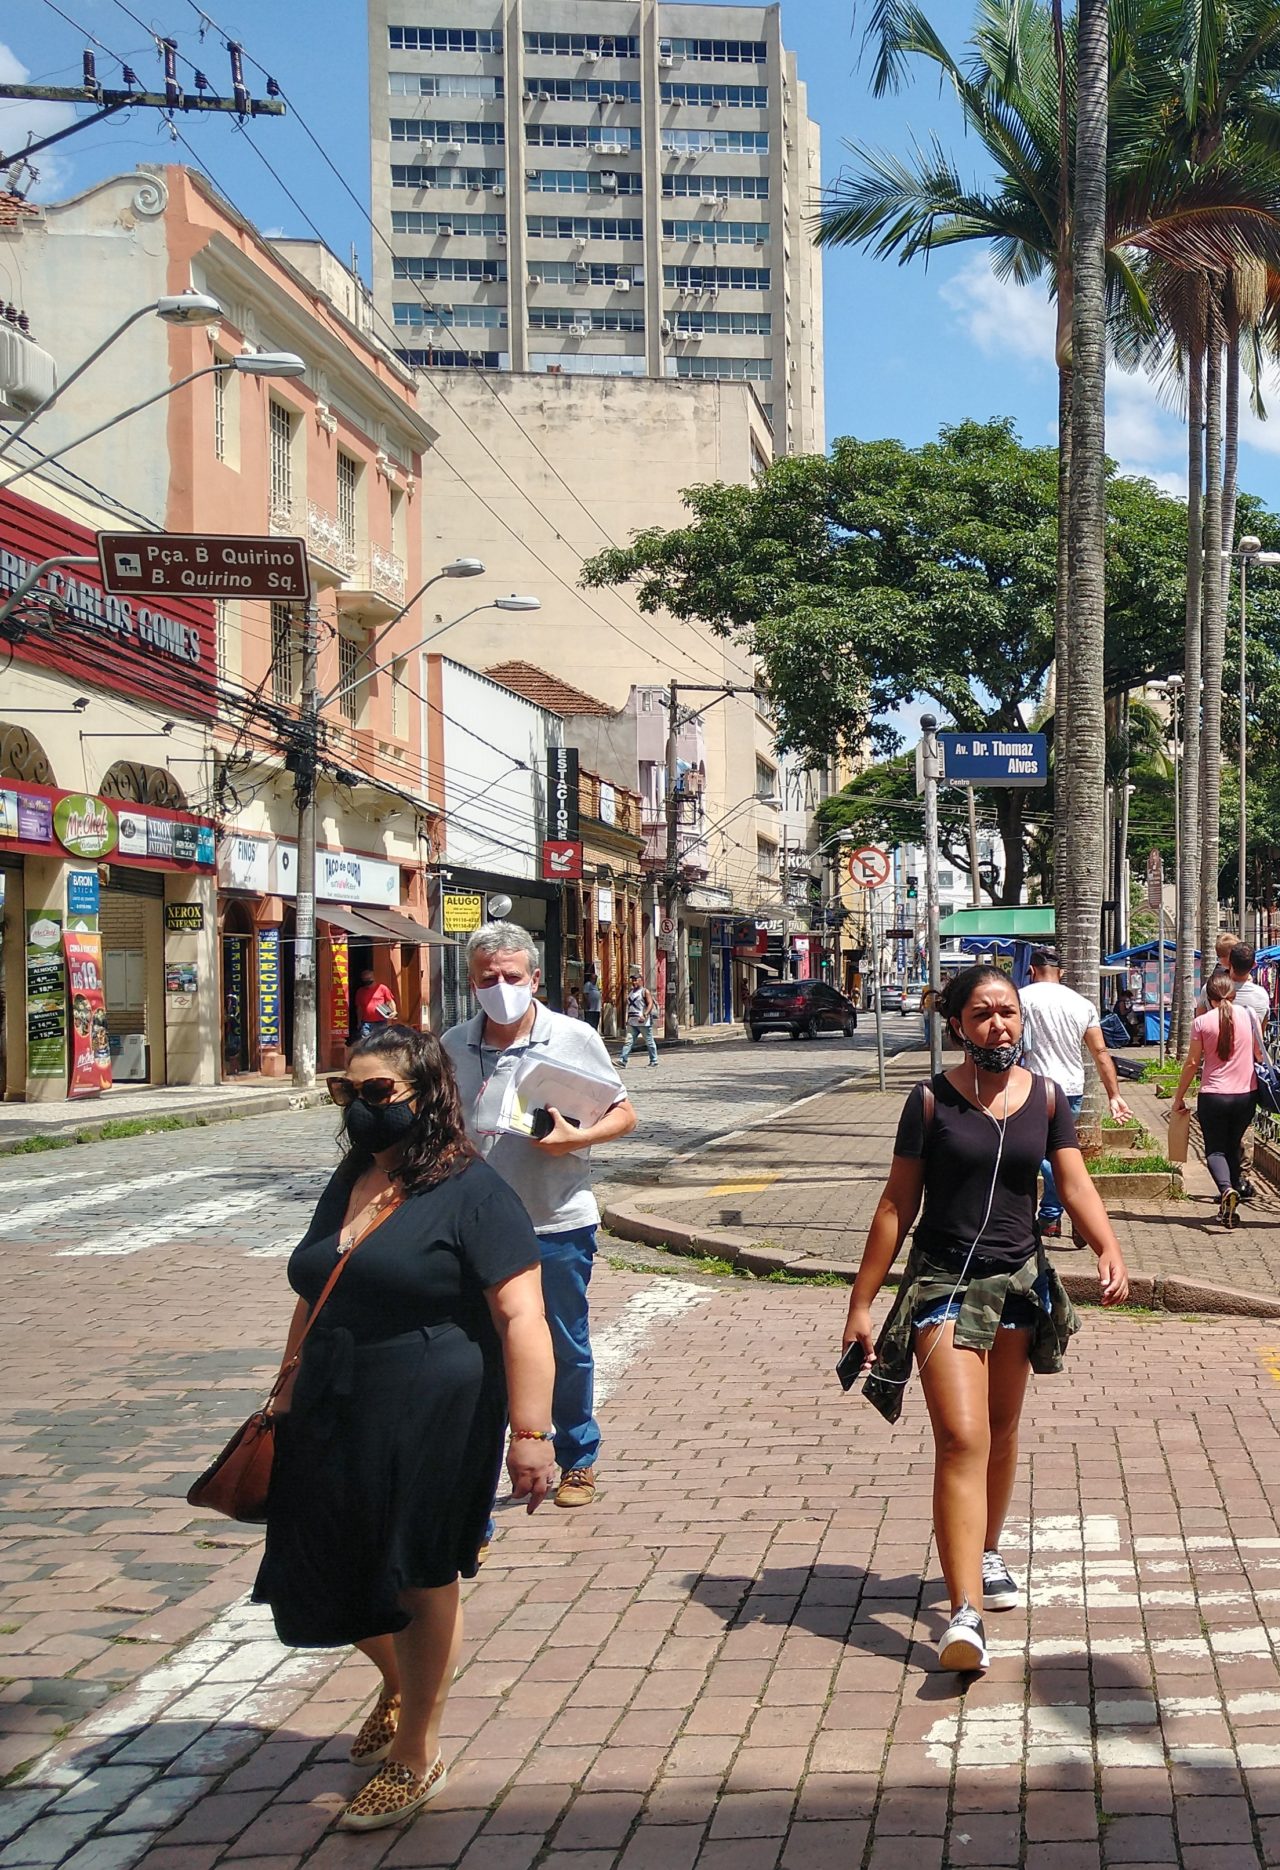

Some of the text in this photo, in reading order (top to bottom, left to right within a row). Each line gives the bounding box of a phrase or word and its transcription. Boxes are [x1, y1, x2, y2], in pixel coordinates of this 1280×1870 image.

[147, 546, 295, 566] Pça. B Quirino
[152, 569, 297, 591] B. Quirino Sq.
[49, 571, 133, 638] CARLOS
[138, 608, 200, 663] GOMES
[955, 741, 1033, 756] Av. Dr. Thomaz
[1008, 759, 1038, 773] Alves
[149, 820, 172, 841] XEROX
[149, 842, 172, 856] INTERNET
[238, 841, 255, 862] FINOS
[325, 858, 361, 888] TACO de OURO
[447, 897, 479, 906] ALUGO
[168, 907, 201, 918] XEROX
[168, 919, 202, 929] INTERNET
[33, 966, 58, 974] ALMOÇO
[259, 941, 278, 1035] EXECUTIVO
[331, 943, 349, 1028] MARMITEX
